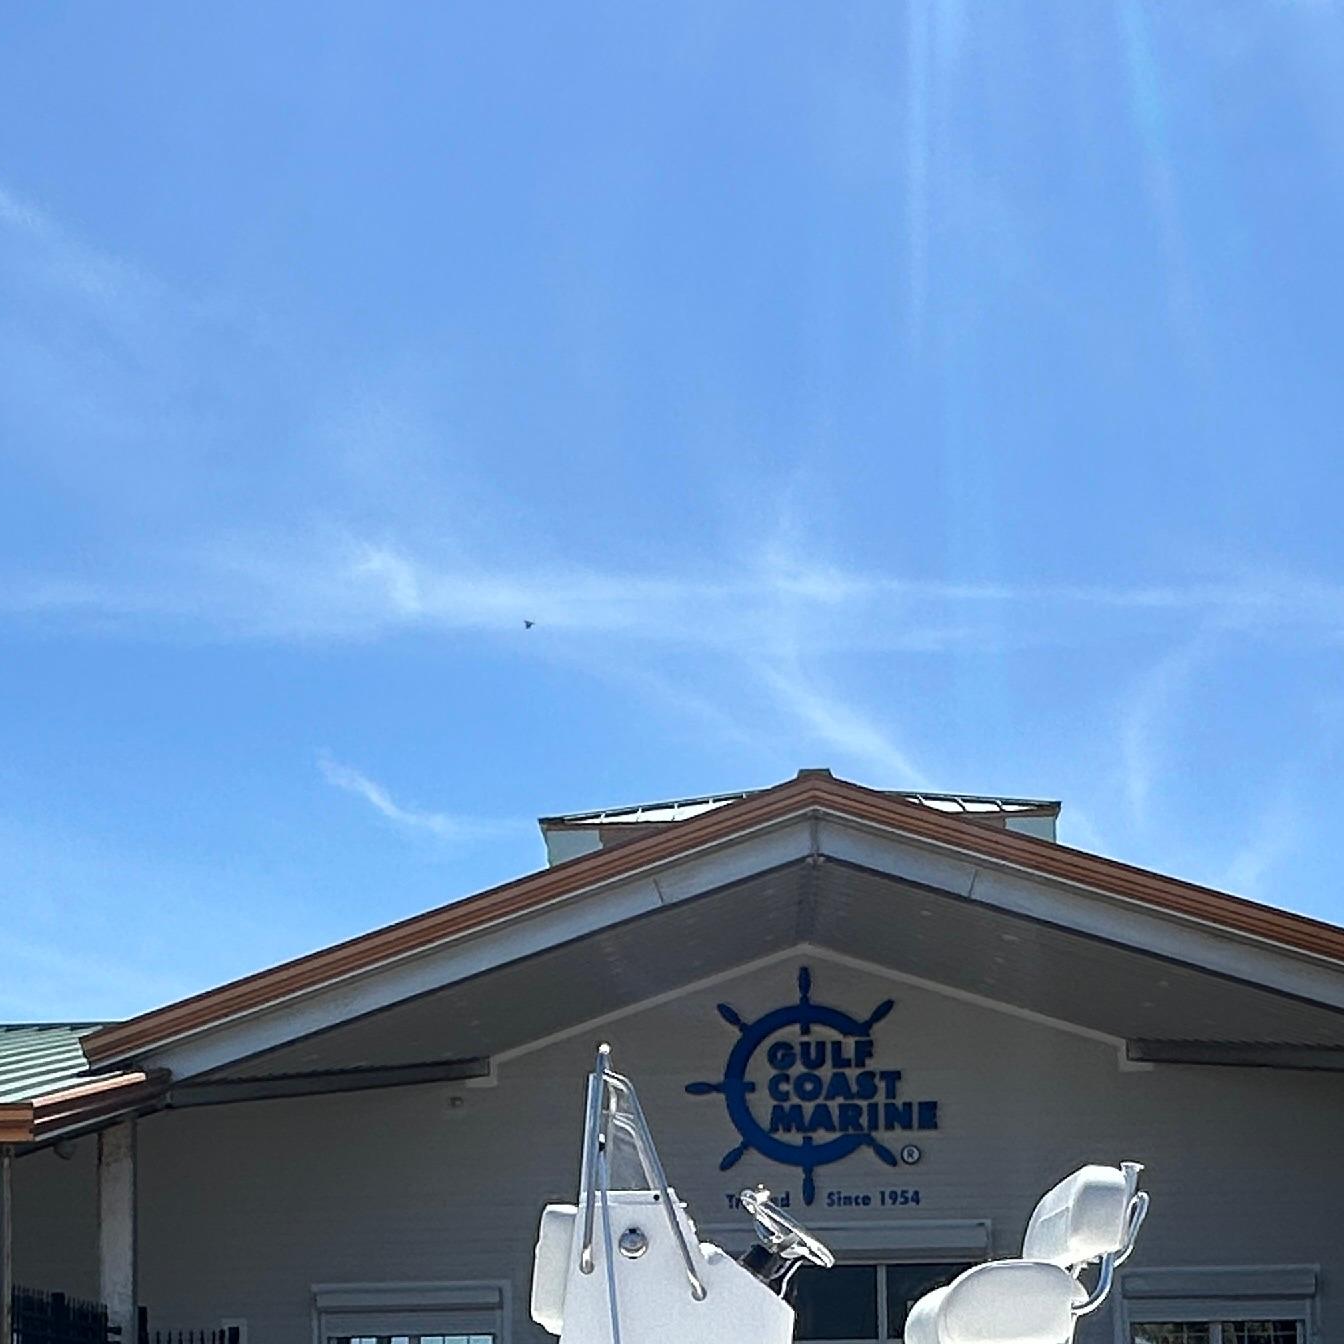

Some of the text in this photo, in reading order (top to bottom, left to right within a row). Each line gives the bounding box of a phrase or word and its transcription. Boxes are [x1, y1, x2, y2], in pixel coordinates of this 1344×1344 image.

[767, 1039, 874, 1071] GULF
[768, 1070, 902, 1102] COAST
[769, 1101, 938, 1133] MARINE
[826, 1190, 871, 1208] Since
[879, 1190, 921, 1207] 1954
